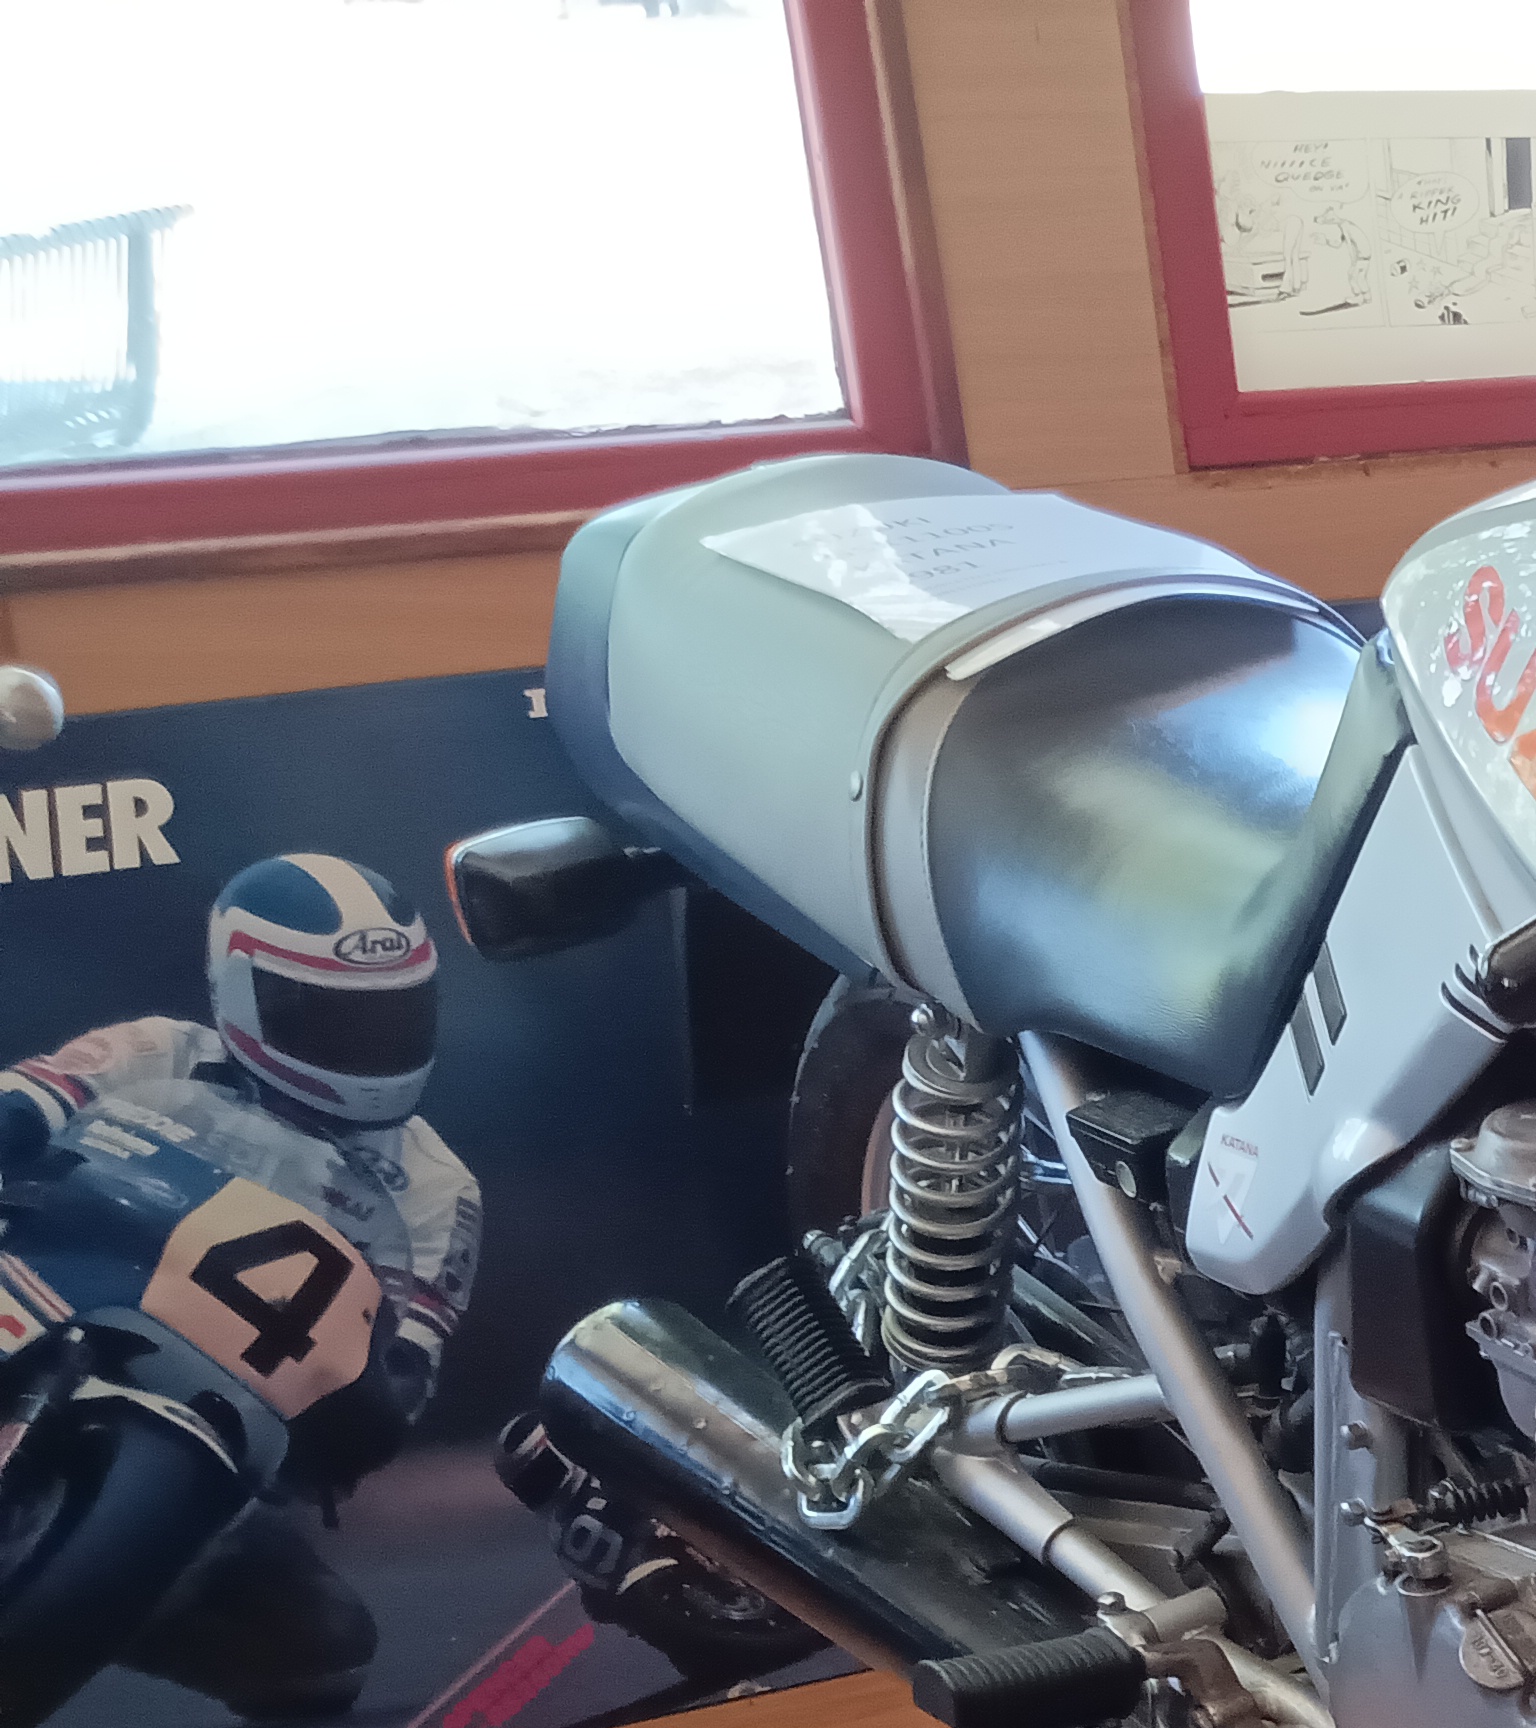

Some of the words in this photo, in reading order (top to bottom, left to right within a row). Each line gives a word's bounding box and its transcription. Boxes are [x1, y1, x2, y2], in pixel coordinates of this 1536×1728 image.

[1411, 194, 1462, 213] KING
[1419, 205, 1457, 226] HIT!
[907, 560, 979, 583] 981
[1221, 1133, 1258, 1157] KATANA
[189, 1219, 354, 1380] 4
